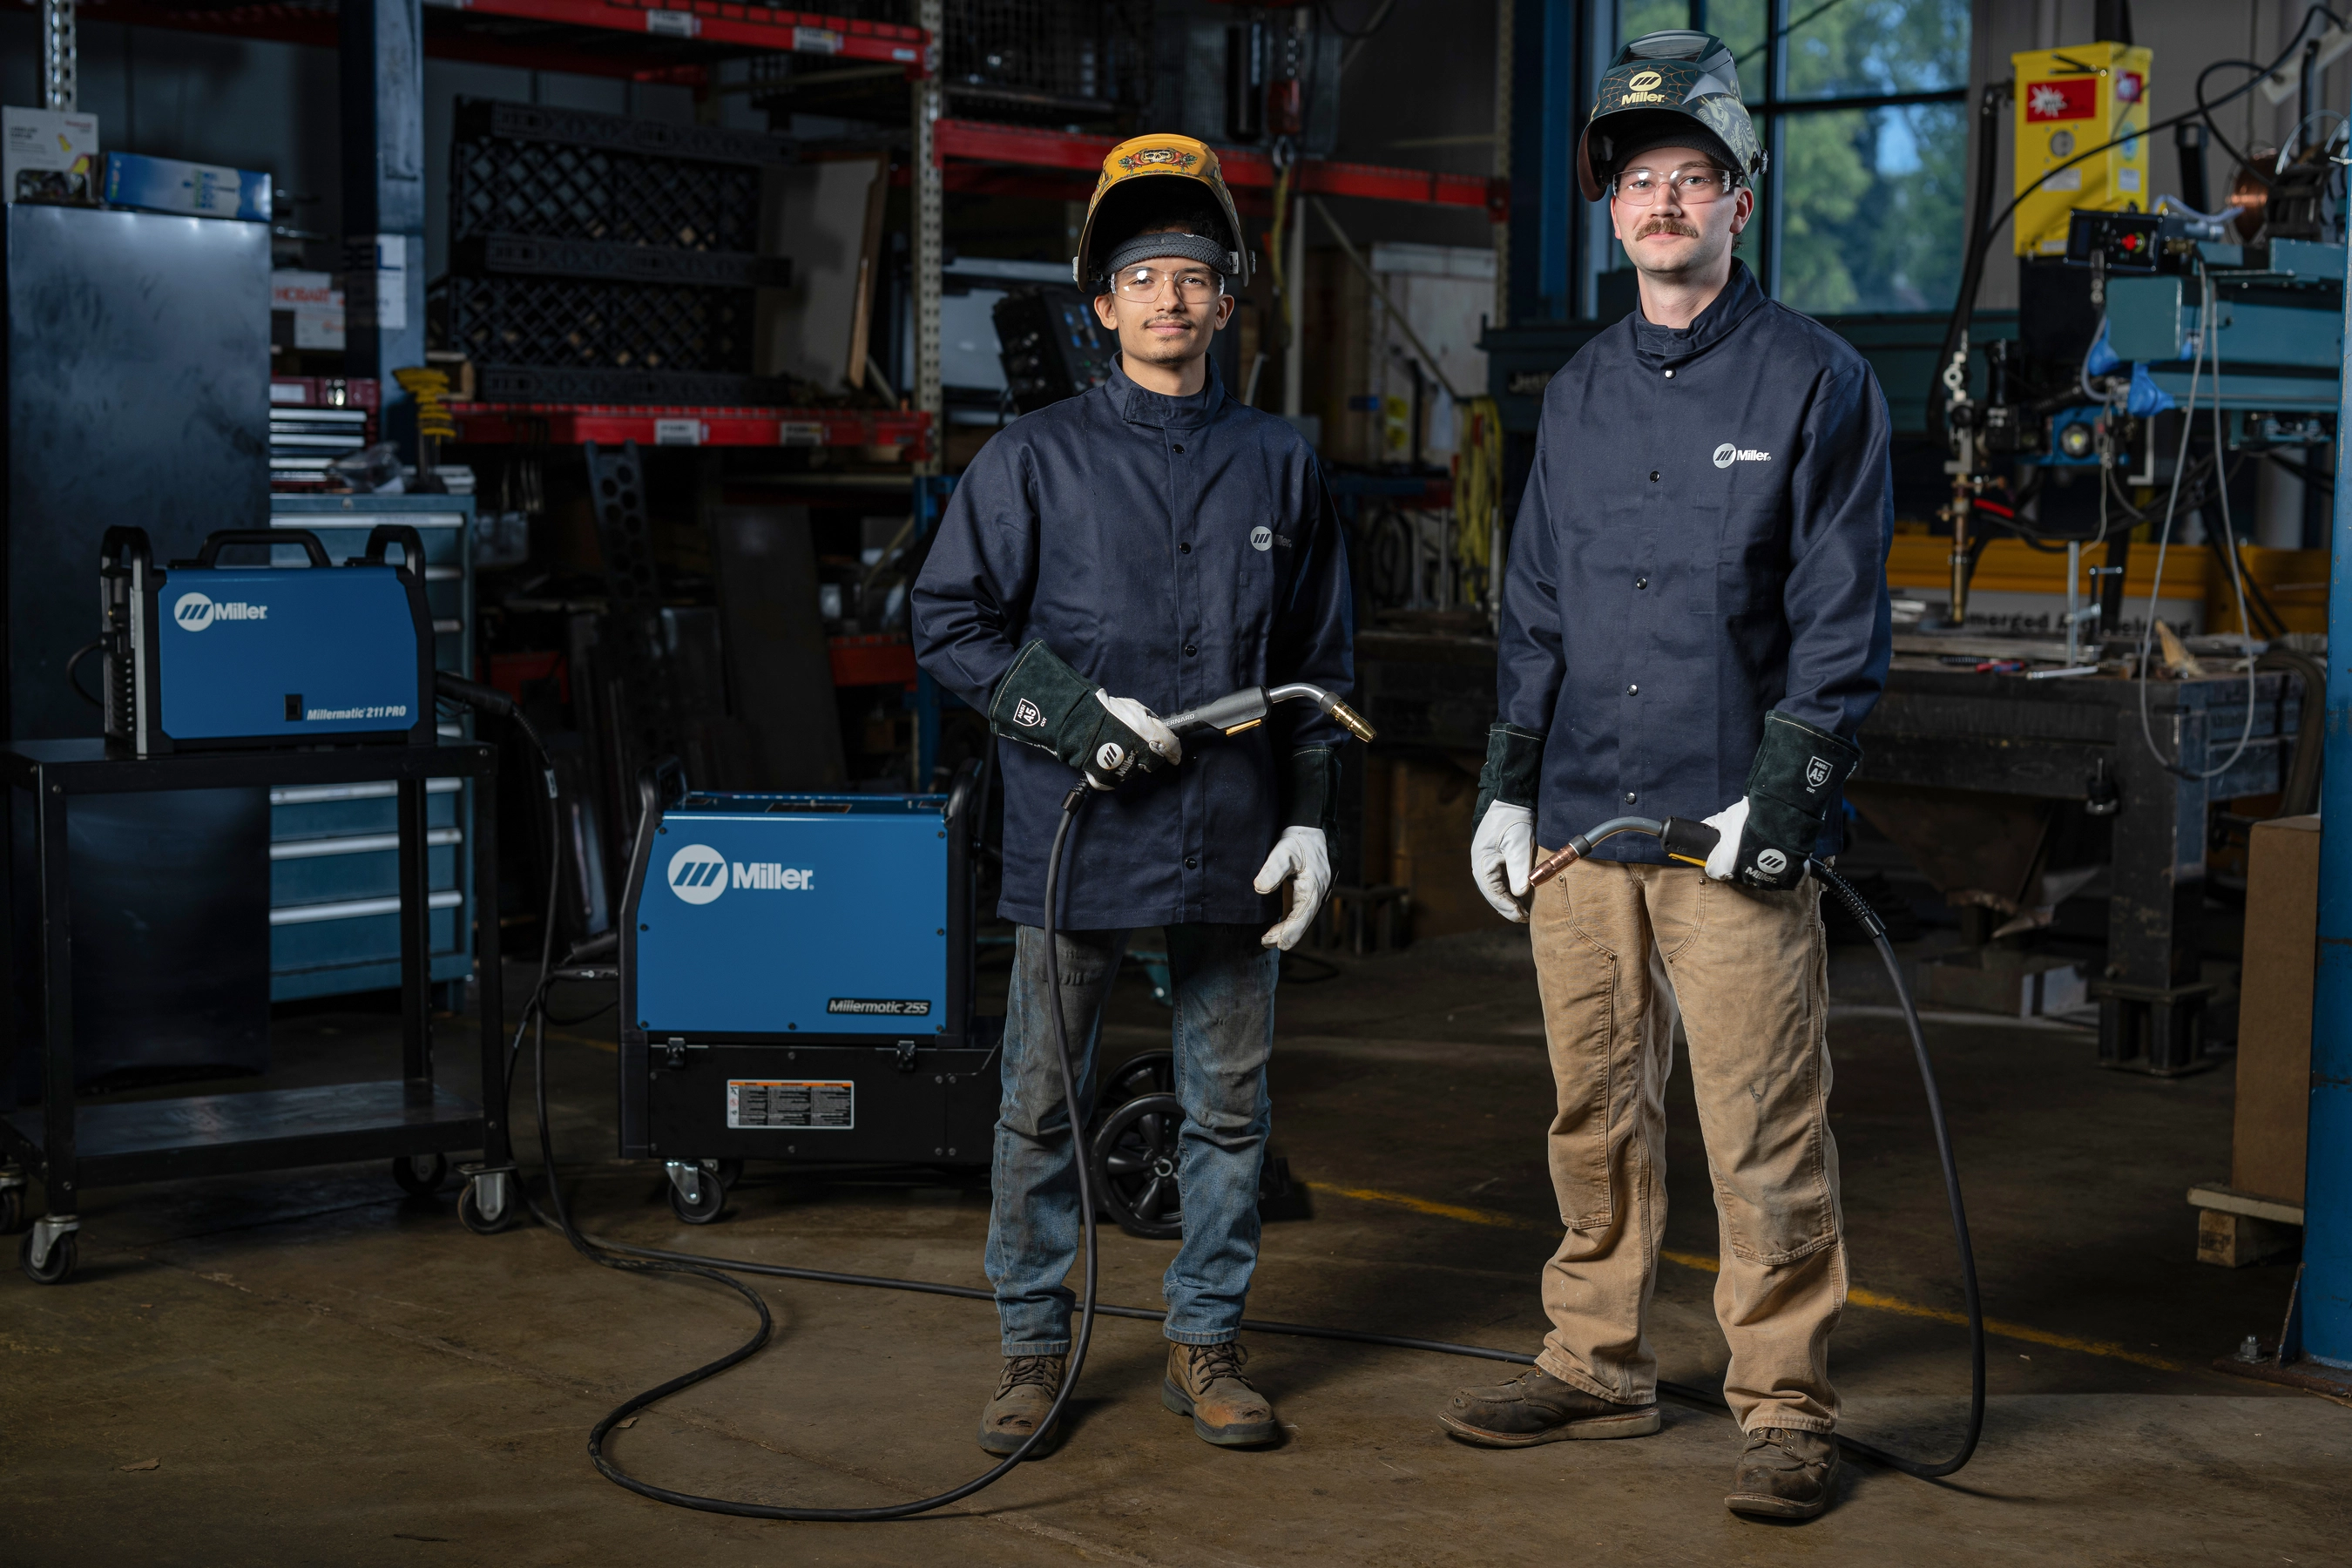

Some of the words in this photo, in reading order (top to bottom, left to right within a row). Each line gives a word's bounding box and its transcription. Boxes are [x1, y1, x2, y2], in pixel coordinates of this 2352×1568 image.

[1621, 91, 1665, 105] Miller
[1736, 449, 1771, 462] Miller
[1274, 534, 1292, 547] iller
[214, 602, 267, 620] Miller
[307, 707, 365, 720] Millermatic
[366, 706, 384, 718] 211
[385, 705, 407, 717] PRO
[1017, 704, 1026, 720] ANSI
[1023, 707, 1037, 724] A5
[1115, 749, 1136, 777] Miller
[1814, 760, 1828, 771] ANSI
[1808, 767, 1825, 782] A5
[733, 862, 814, 890] Miller
[1745, 866, 1777, 884] Miller
[828, 999, 904, 1013] Millermatic
[902, 1002, 929, 1014] 255
